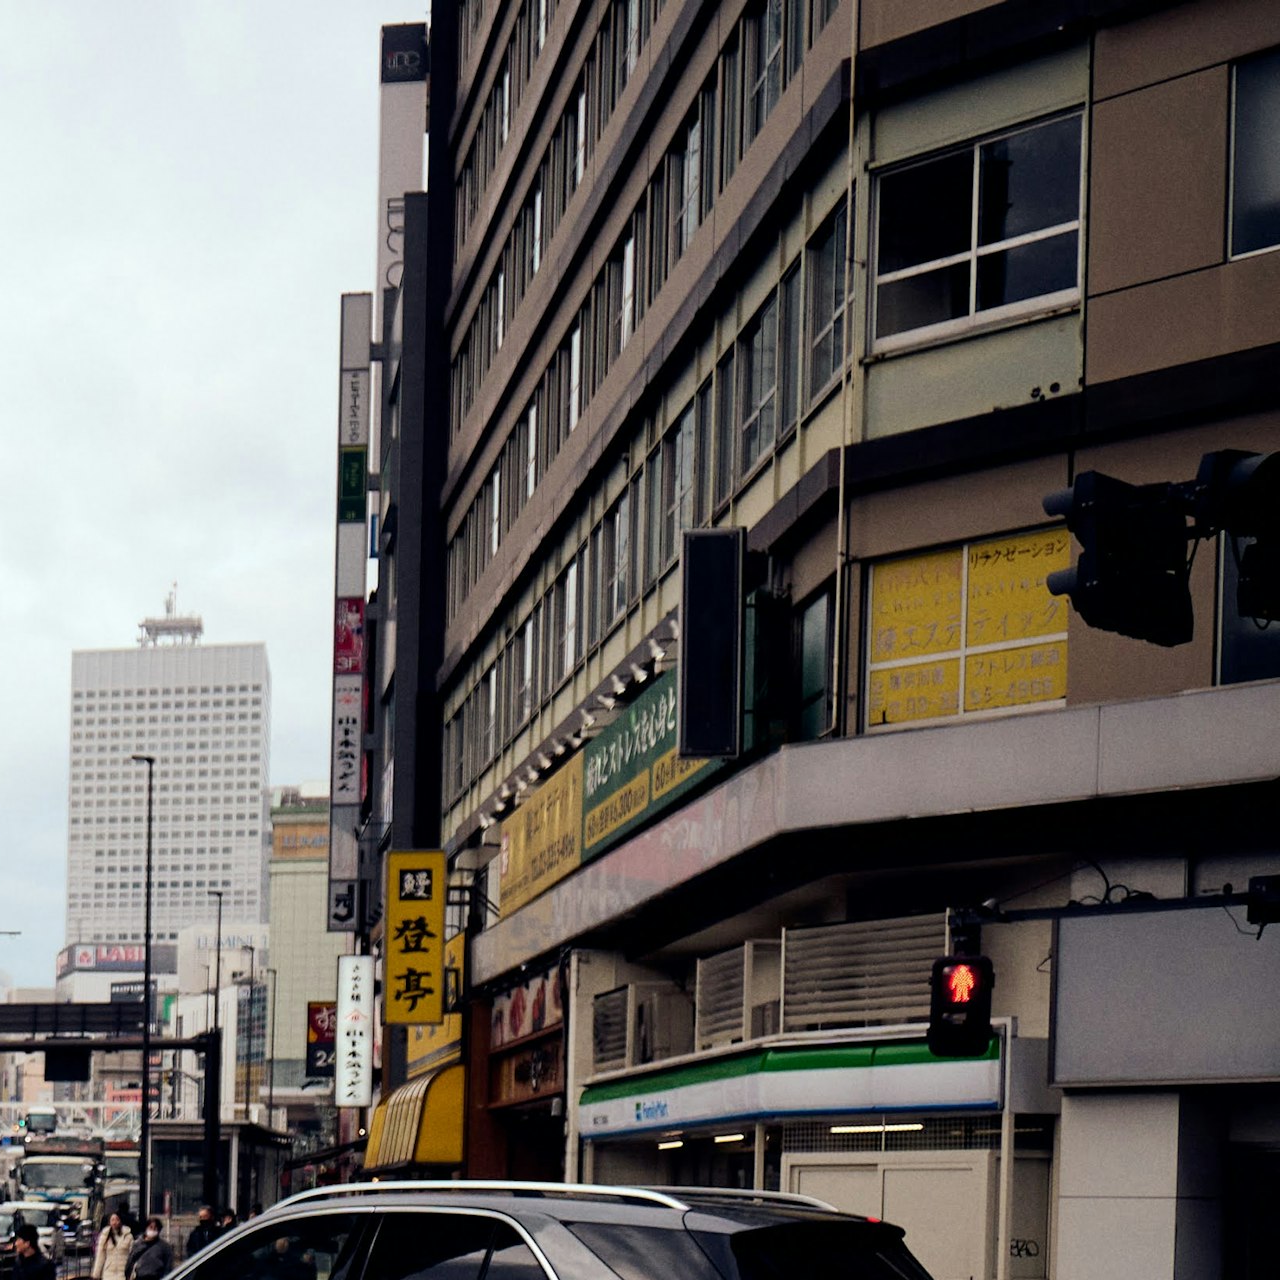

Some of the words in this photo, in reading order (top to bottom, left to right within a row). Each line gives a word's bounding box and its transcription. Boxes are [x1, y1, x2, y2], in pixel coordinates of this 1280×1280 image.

[971, 539, 1068, 571] リラクゼーション
[392, 915, 438, 1013] 登亭
